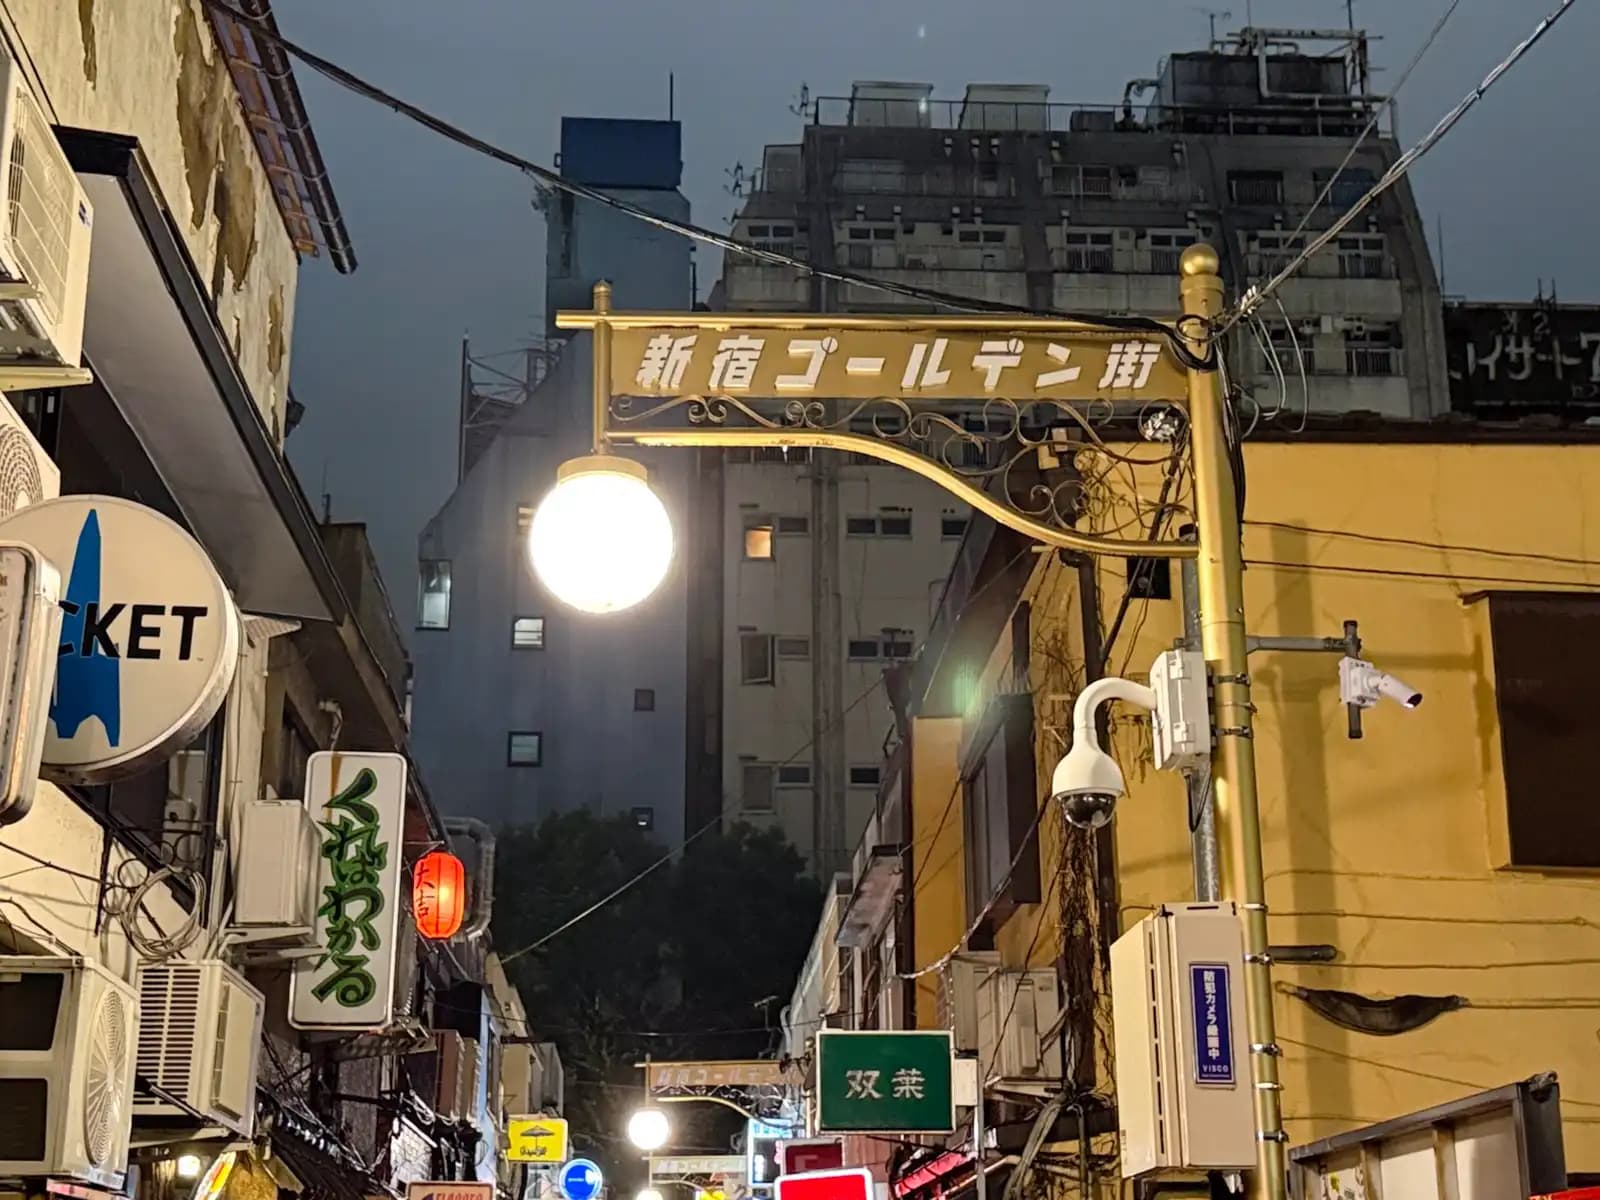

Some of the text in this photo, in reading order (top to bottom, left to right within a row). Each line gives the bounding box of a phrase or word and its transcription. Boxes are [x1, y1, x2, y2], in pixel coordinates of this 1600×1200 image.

[635, 334, 1162, 391] 新宿ゴールデン街
[845, 1068, 926, 1099] 双葉
